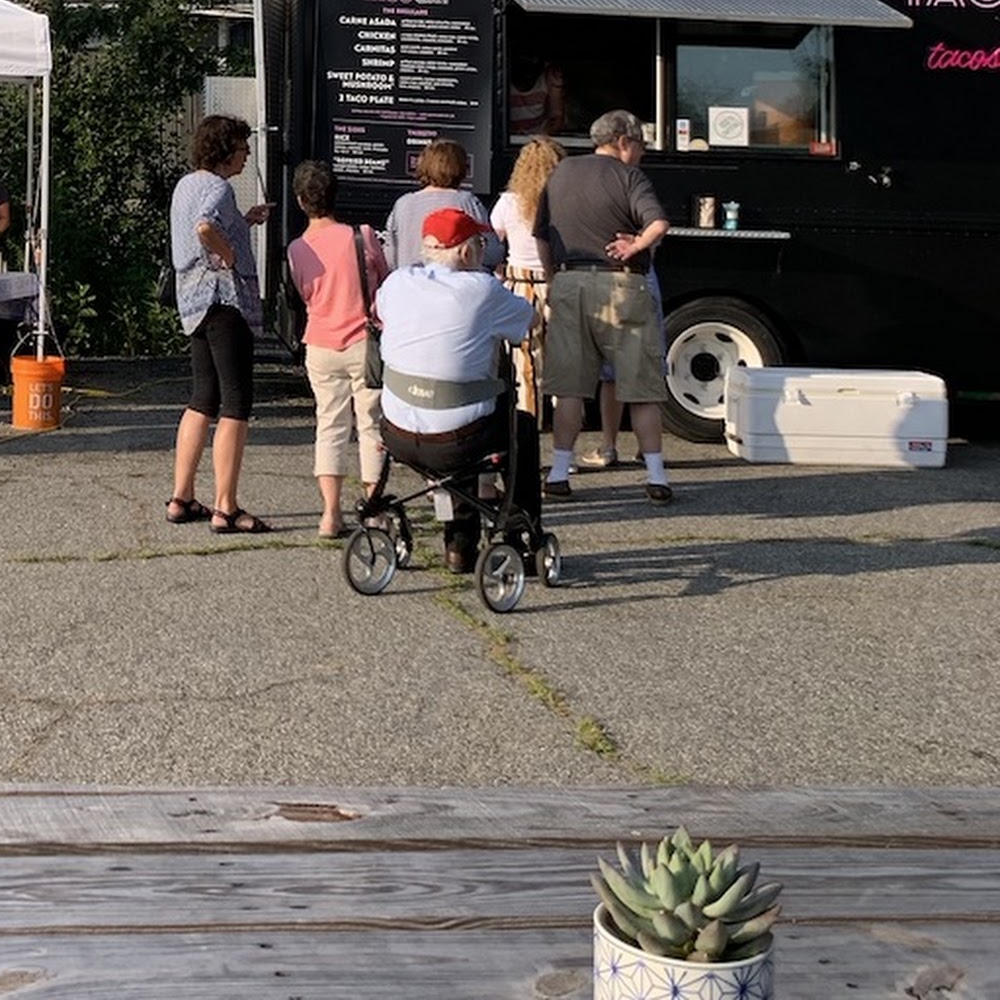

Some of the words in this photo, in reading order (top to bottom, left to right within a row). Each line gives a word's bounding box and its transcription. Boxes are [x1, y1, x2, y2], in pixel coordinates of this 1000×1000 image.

[339, 16, 368, 25] CARNE
[369, 17, 397, 27] ASADA
[357, 31, 397, 41] CHICKEN
[354, 44, 397, 55] CARNITAS
[361, 58, 395, 67] SHRIMP
[326, 71, 354, 80] SWEET
[355, 72, 387, 82] POTATO
[345, 94, 368, 103] TACO
[369, 96, 394, 105] PLATE
[29, 393, 53, 410] DO
